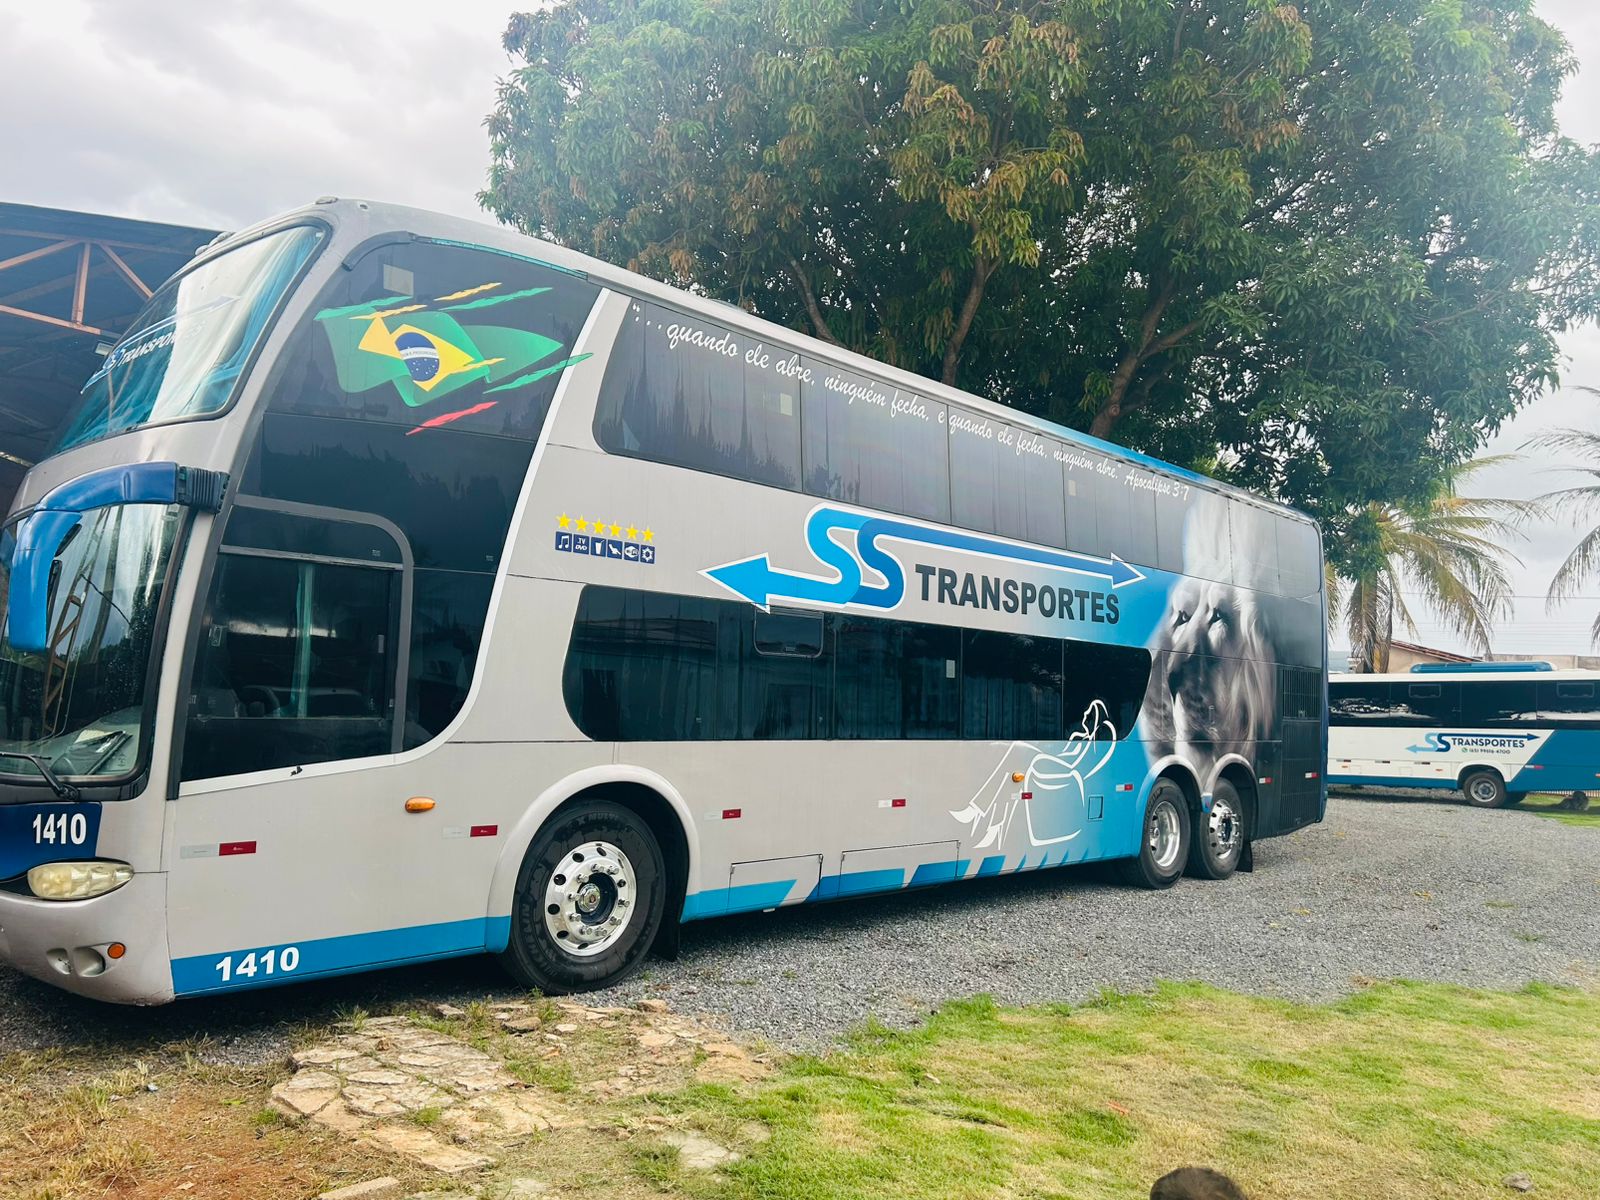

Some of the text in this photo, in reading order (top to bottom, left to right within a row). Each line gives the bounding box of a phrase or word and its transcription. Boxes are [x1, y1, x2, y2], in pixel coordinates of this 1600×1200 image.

[745, 344, 769, 368] ele
[775, 354, 815, 386] abre,
[824, 374, 887, 406] ninguém
[890, 389, 929, 421] fecha,
[938, 411, 945, 423] e
[949, 414, 992, 439] quando
[997, 426, 1013, 445] ele
[1053, 449, 1093, 471] ninguém
[1124, 469, 1171, 497] Apocalipse
[914, 563, 1120, 625] TRANSPORTES
[1451, 737, 1525, 749] TRANSPORTES
[32, 813, 87, 845] 1410
[215, 947, 300, 981] 1410
